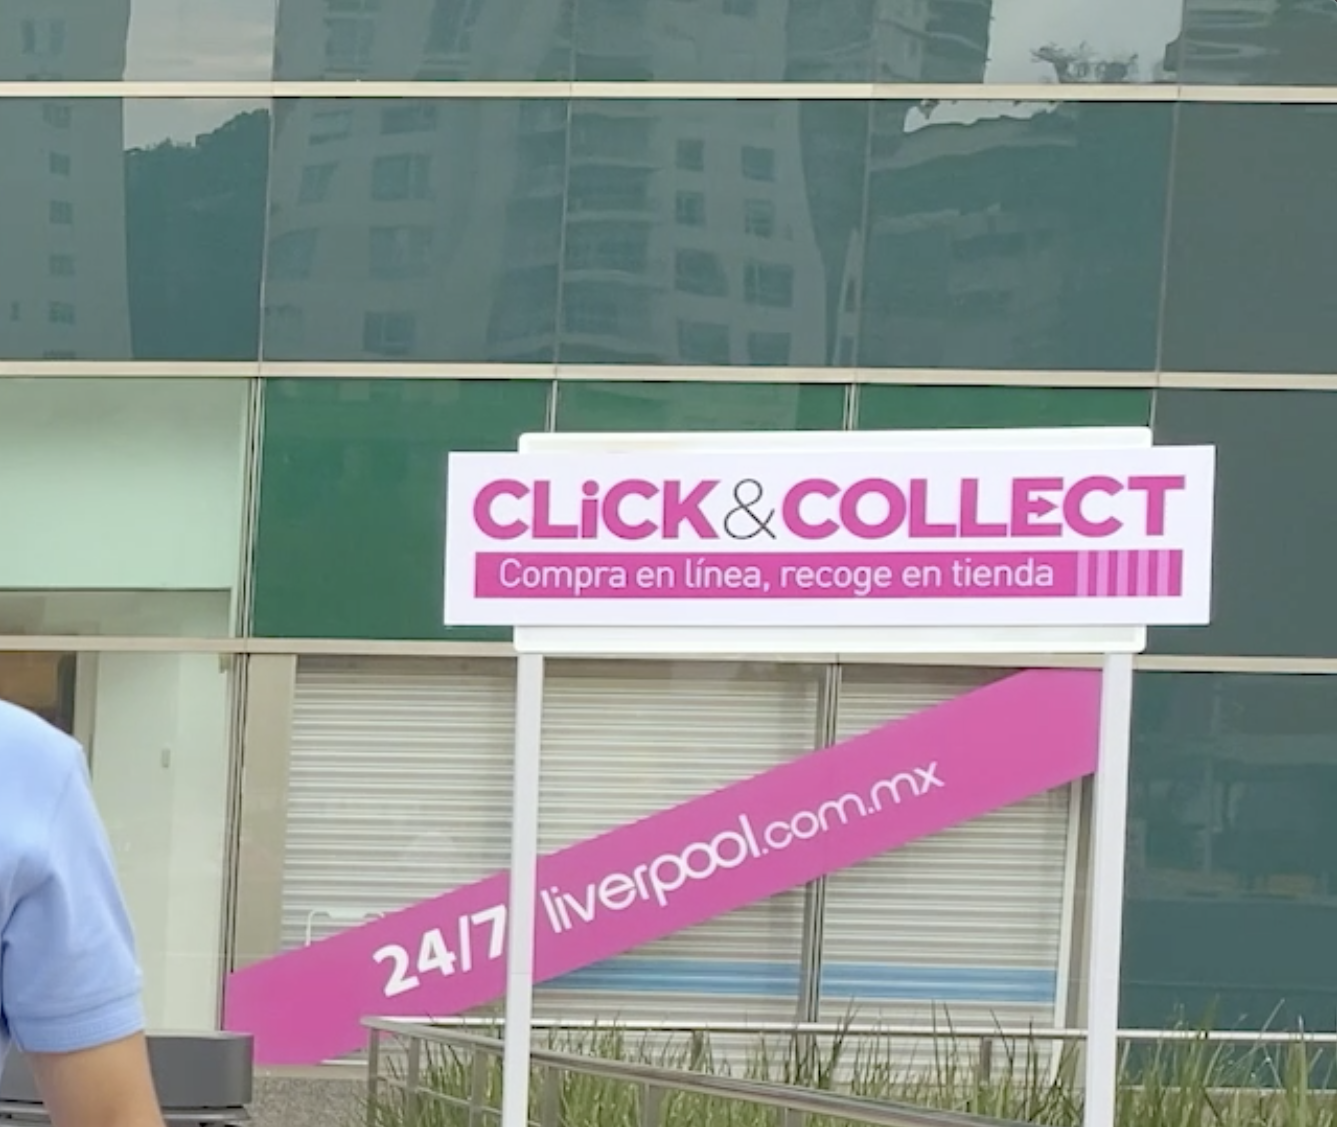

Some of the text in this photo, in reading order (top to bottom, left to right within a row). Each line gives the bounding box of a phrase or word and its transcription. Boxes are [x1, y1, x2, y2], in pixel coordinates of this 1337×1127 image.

[498, 556, 1055, 597] Compra en línea, recoge en tienda
[372, 760, 946, 998] 24/7 liverpool.com.mx
